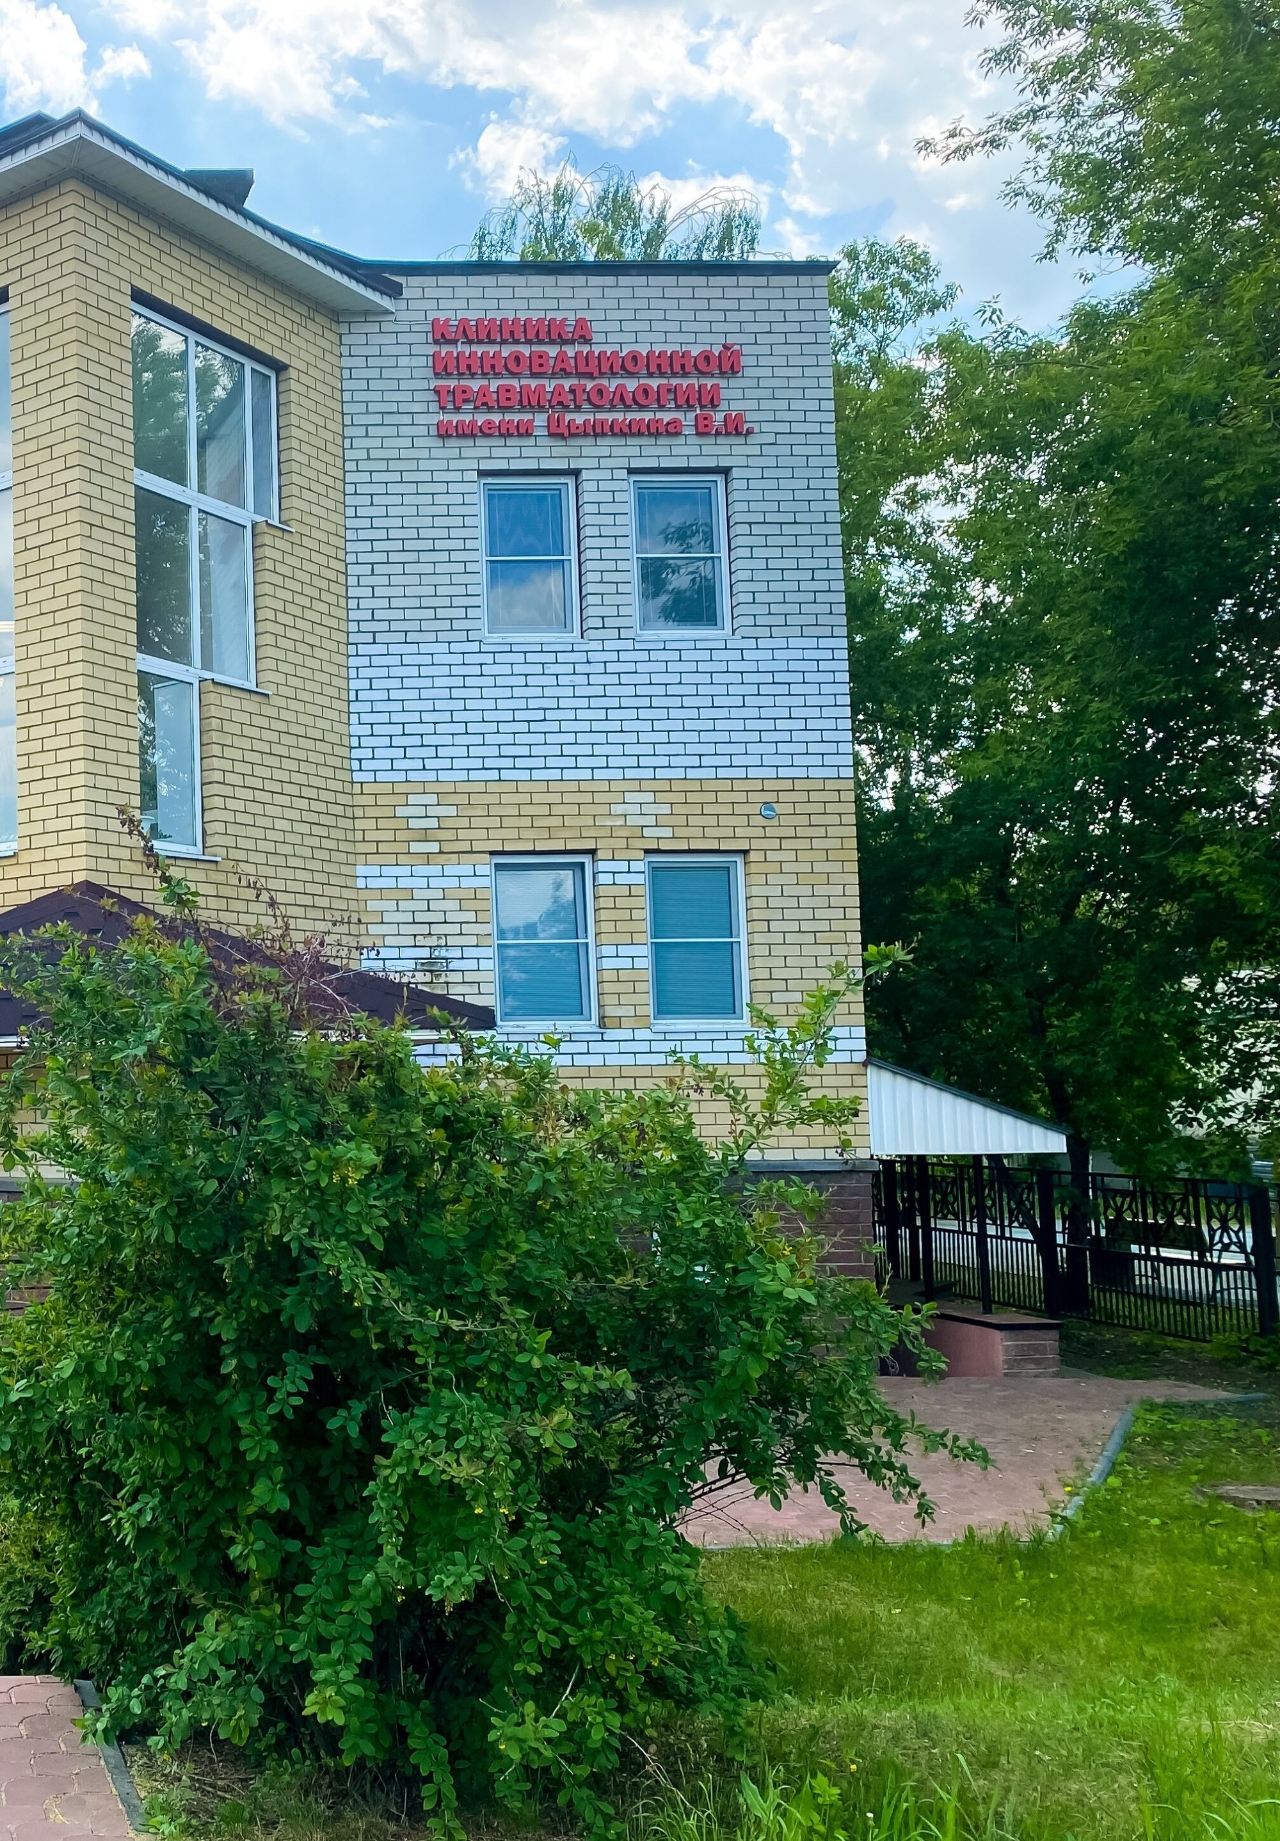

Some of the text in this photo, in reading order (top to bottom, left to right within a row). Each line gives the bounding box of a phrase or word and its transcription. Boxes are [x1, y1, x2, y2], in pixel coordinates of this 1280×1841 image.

[431, 317, 593, 344] КЛИНИКА
[432, 343, 742, 379] ИННОВАЦИОННОЙ
[434, 383, 722, 409] ТРАВМАТОЛОГИИ
[437, 412, 755, 440] имени Цыпкина В.И.
